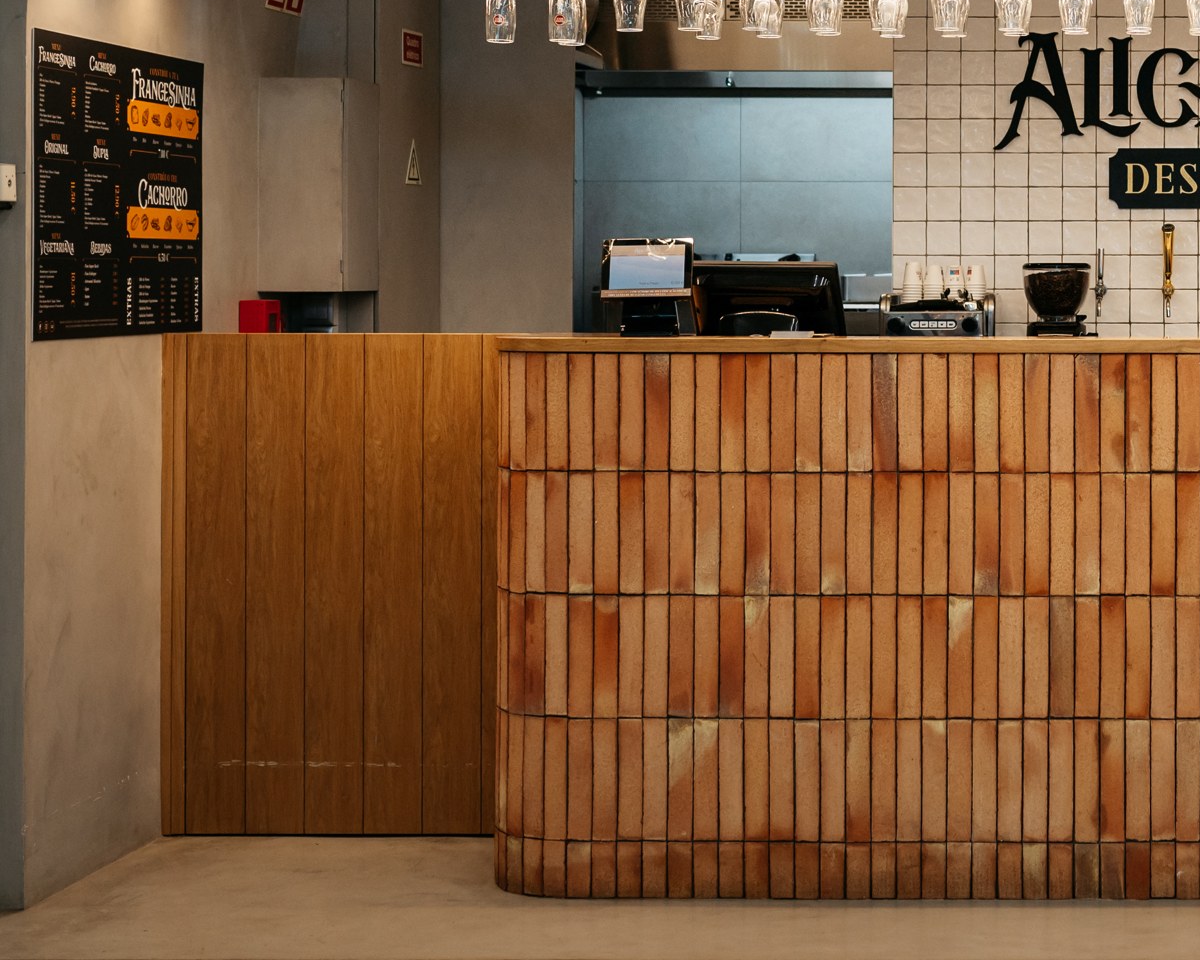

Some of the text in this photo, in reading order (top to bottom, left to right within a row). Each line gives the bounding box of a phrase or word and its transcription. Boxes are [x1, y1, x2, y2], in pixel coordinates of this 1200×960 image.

[38, 46, 76, 69] FRANCESINHA
[89, 56, 116, 76] CACHORRO
[131, 68, 196, 110] FRANCESINHA
[44, 140, 69, 155] ORIGINAL
[138, 178, 188, 212] CACHORRO
[40, 240, 75, 255] VEGETARIANA
[90, 241, 112, 256] BEBIDAS
